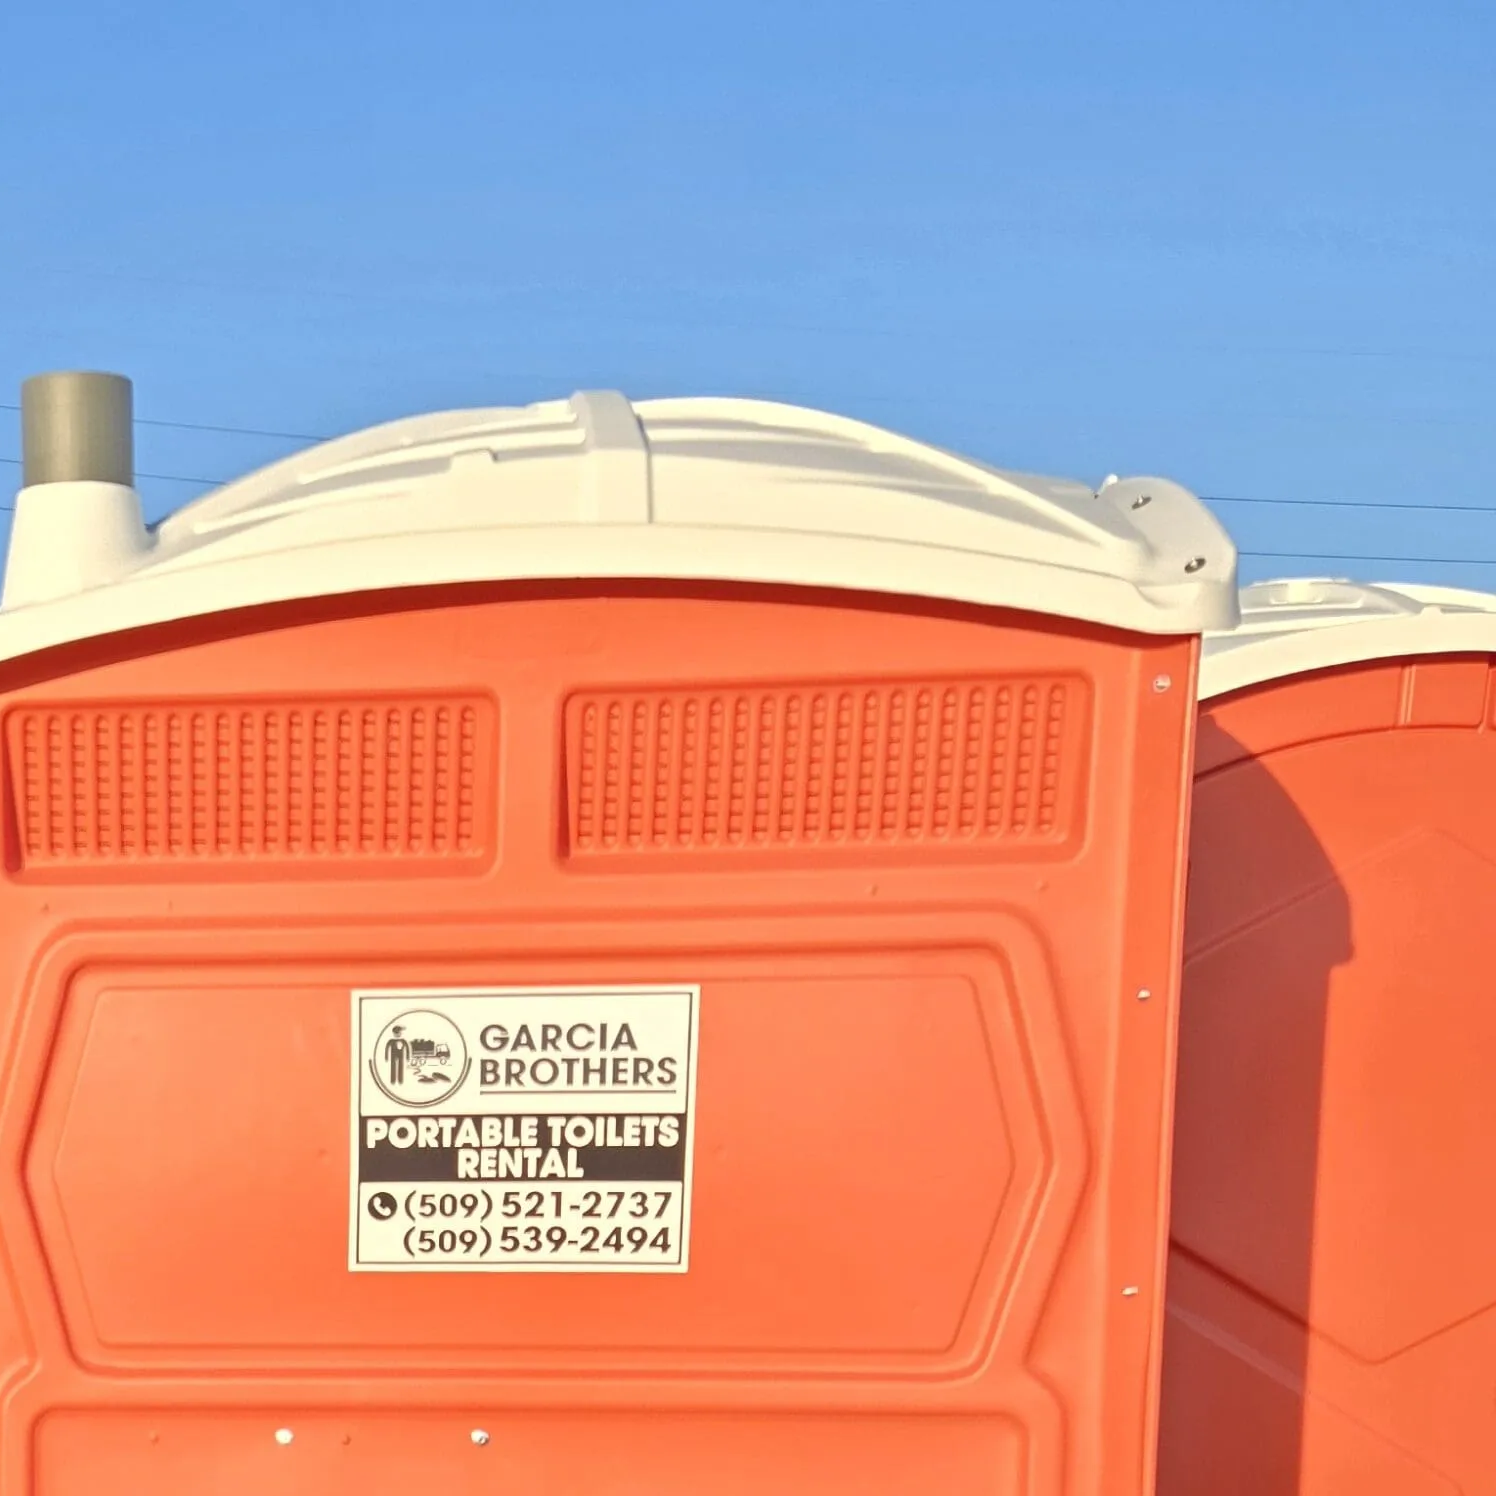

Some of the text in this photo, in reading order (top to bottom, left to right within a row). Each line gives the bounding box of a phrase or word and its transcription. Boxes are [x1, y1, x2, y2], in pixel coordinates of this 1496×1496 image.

[479, 1022, 638, 1053] GARCIA
[479, 1056, 678, 1087] BROTHERS
[366, 1115, 679, 1148] PORTABLE TOILETS
[457, 1148, 584, 1179] RENTAL
[404, 1190, 673, 1221] (509) 521-2737
[403, 1226, 672, 1257] (509) 539-2494
